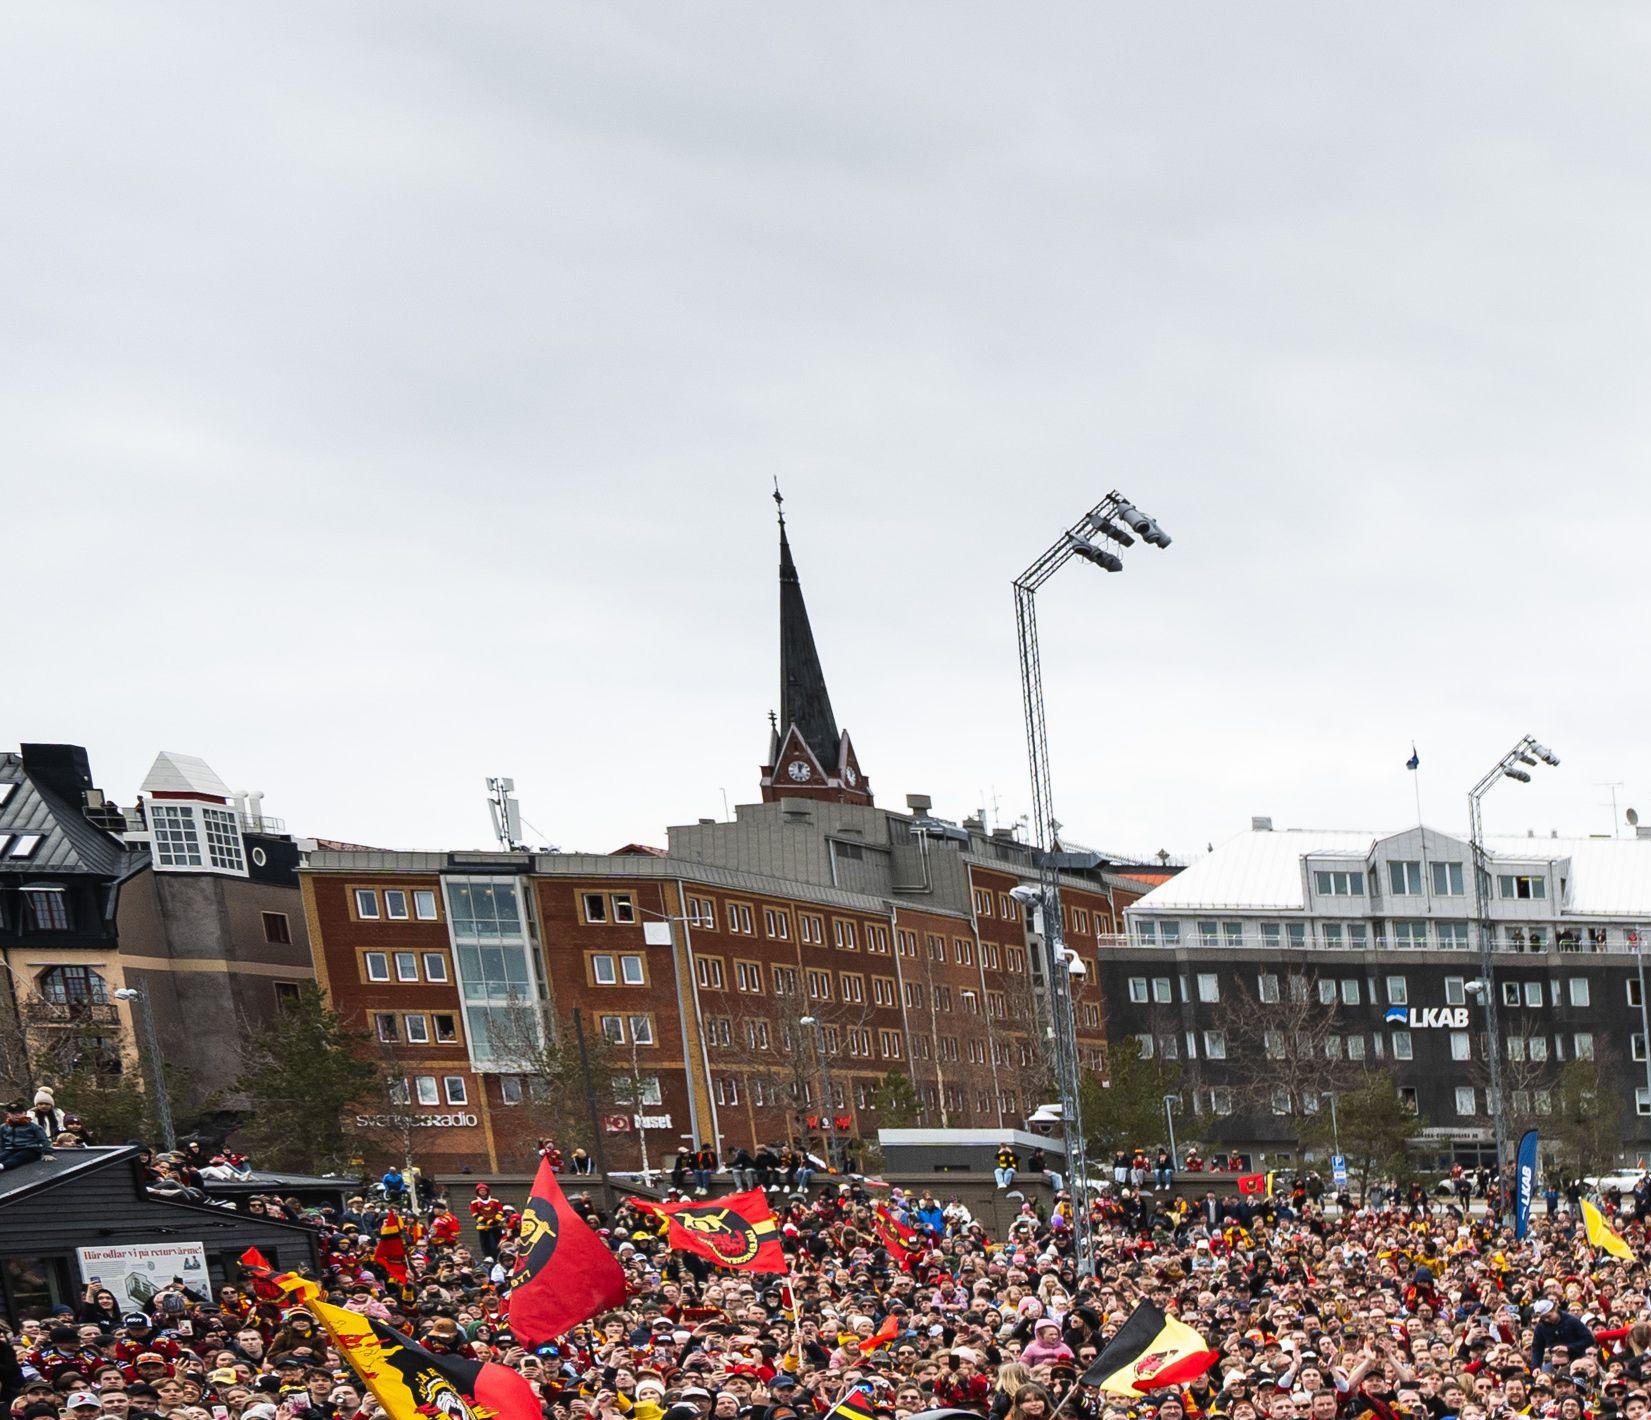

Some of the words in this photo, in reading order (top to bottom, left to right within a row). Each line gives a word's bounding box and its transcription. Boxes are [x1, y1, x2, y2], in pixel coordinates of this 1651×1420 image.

[1409, 1007, 1470, 1028] LKAB
[1520, 1165, 1533, 1206] LKAB
[102, 1248, 128, 1263] odlar
